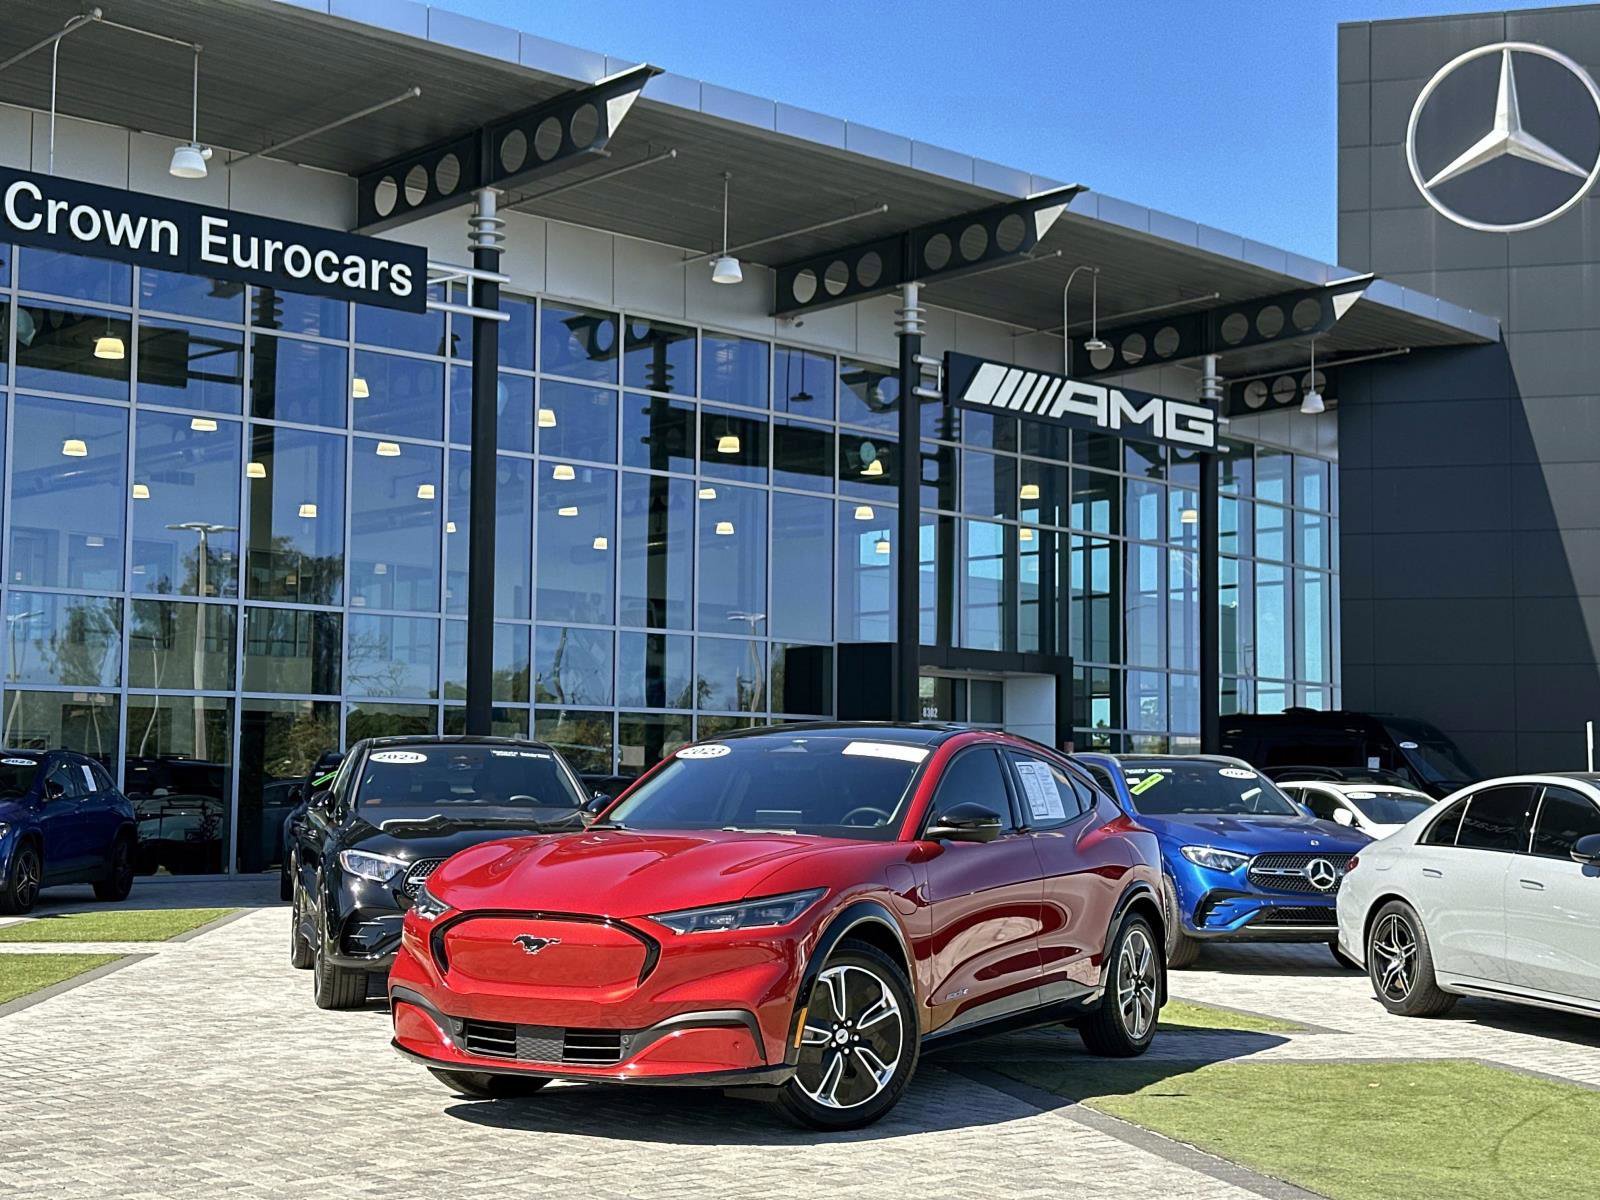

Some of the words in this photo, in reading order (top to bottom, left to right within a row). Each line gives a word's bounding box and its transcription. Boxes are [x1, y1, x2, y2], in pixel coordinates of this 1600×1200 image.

[4, 180, 179, 256] Crown
[201, 216, 413, 297] Eurocars
[1048, 379, 1214, 448] AMG
